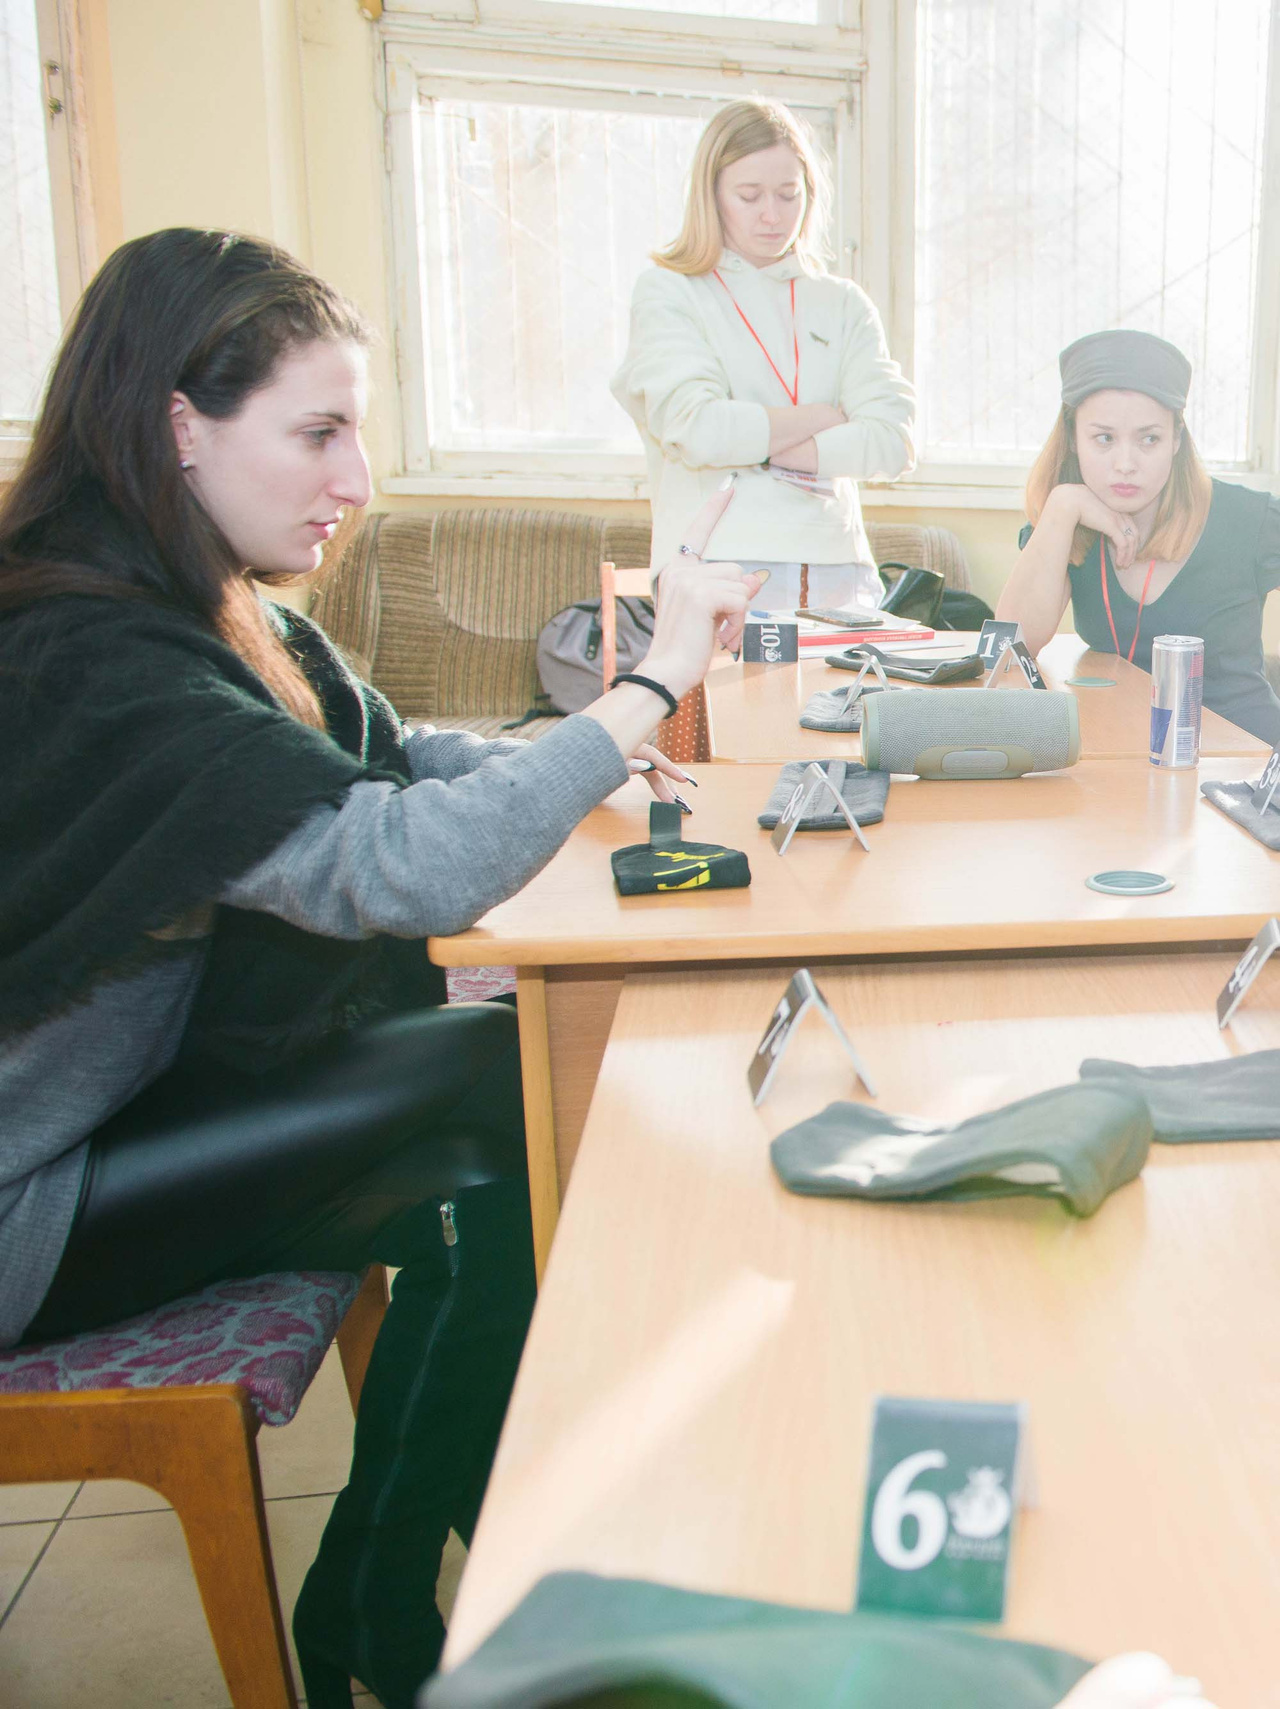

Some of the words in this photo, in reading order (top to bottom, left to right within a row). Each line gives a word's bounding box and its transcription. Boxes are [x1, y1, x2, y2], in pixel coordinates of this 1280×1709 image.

[760, 624, 781, 648] 10
[979, 632, 997, 658] 1
[1020, 655, 1038, 684] 2
[1259, 752, 1279, 789] 3
[781, 783, 804, 824] 8
[870, 1448, 949, 1571] 6
